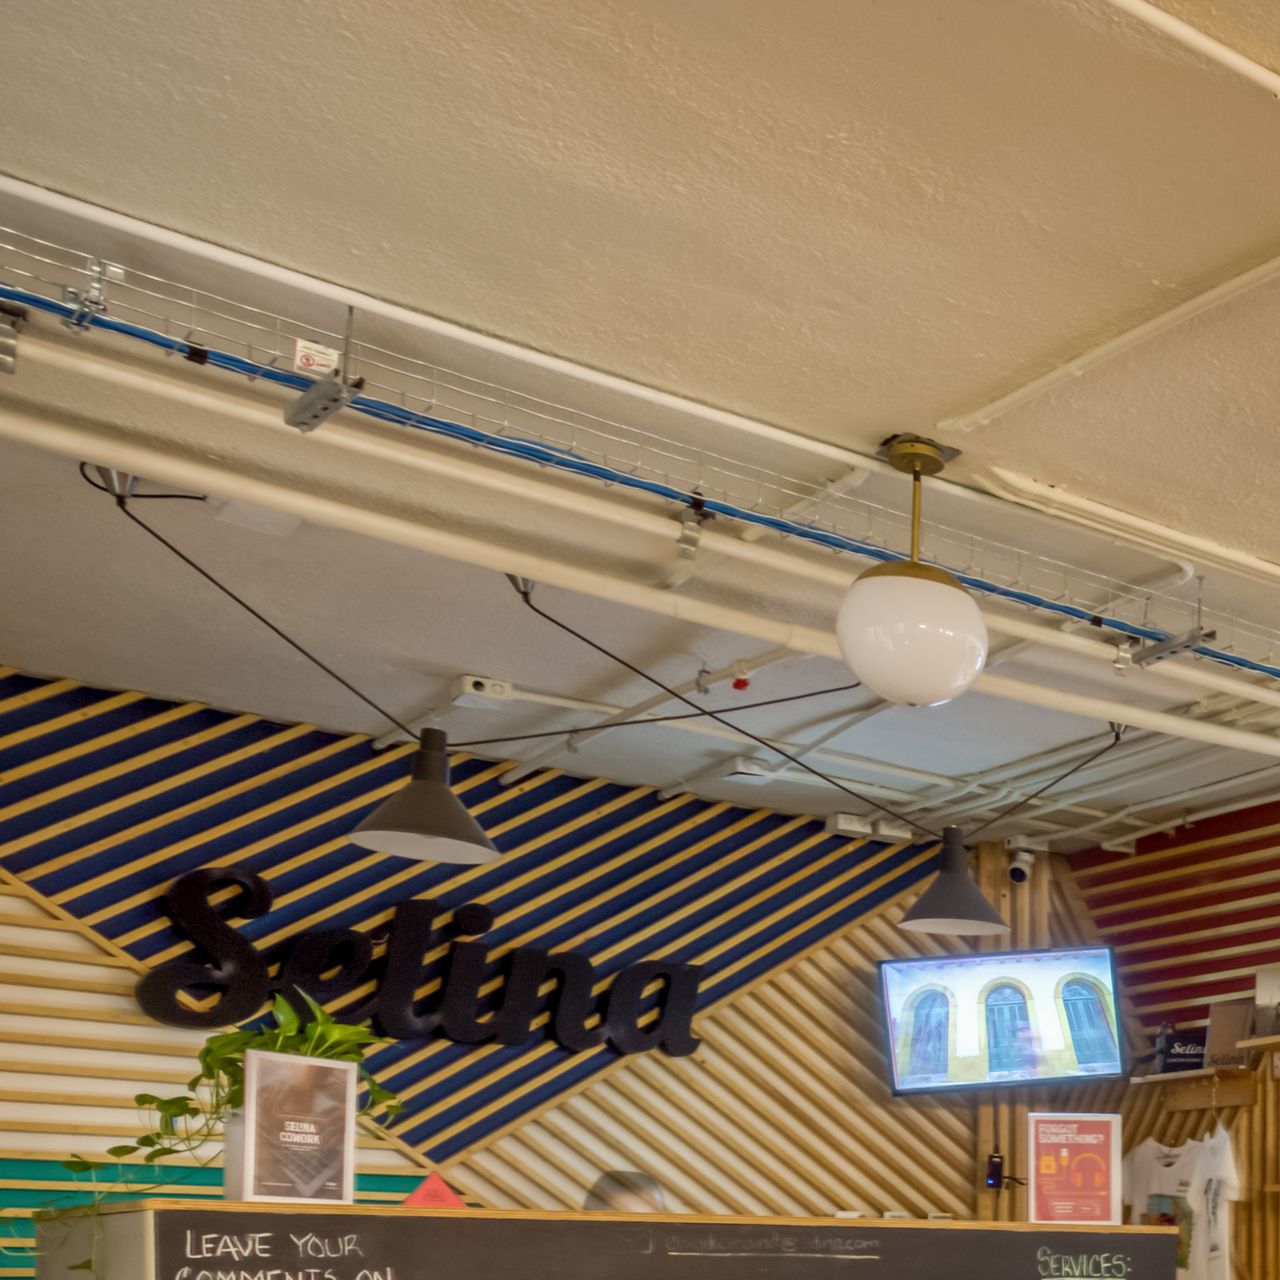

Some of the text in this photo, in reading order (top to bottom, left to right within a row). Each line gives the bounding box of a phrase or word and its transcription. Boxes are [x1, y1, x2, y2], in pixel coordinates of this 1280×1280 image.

[136, 868, 703, 1058] Selina
[279, 1132, 321, 1144] COWORK
[284, 1121, 316, 1133] SELINA
[186, 1230, 365, 1261] LEAVE YOUR
[1037, 1247, 1132, 1277] SERVICES:
